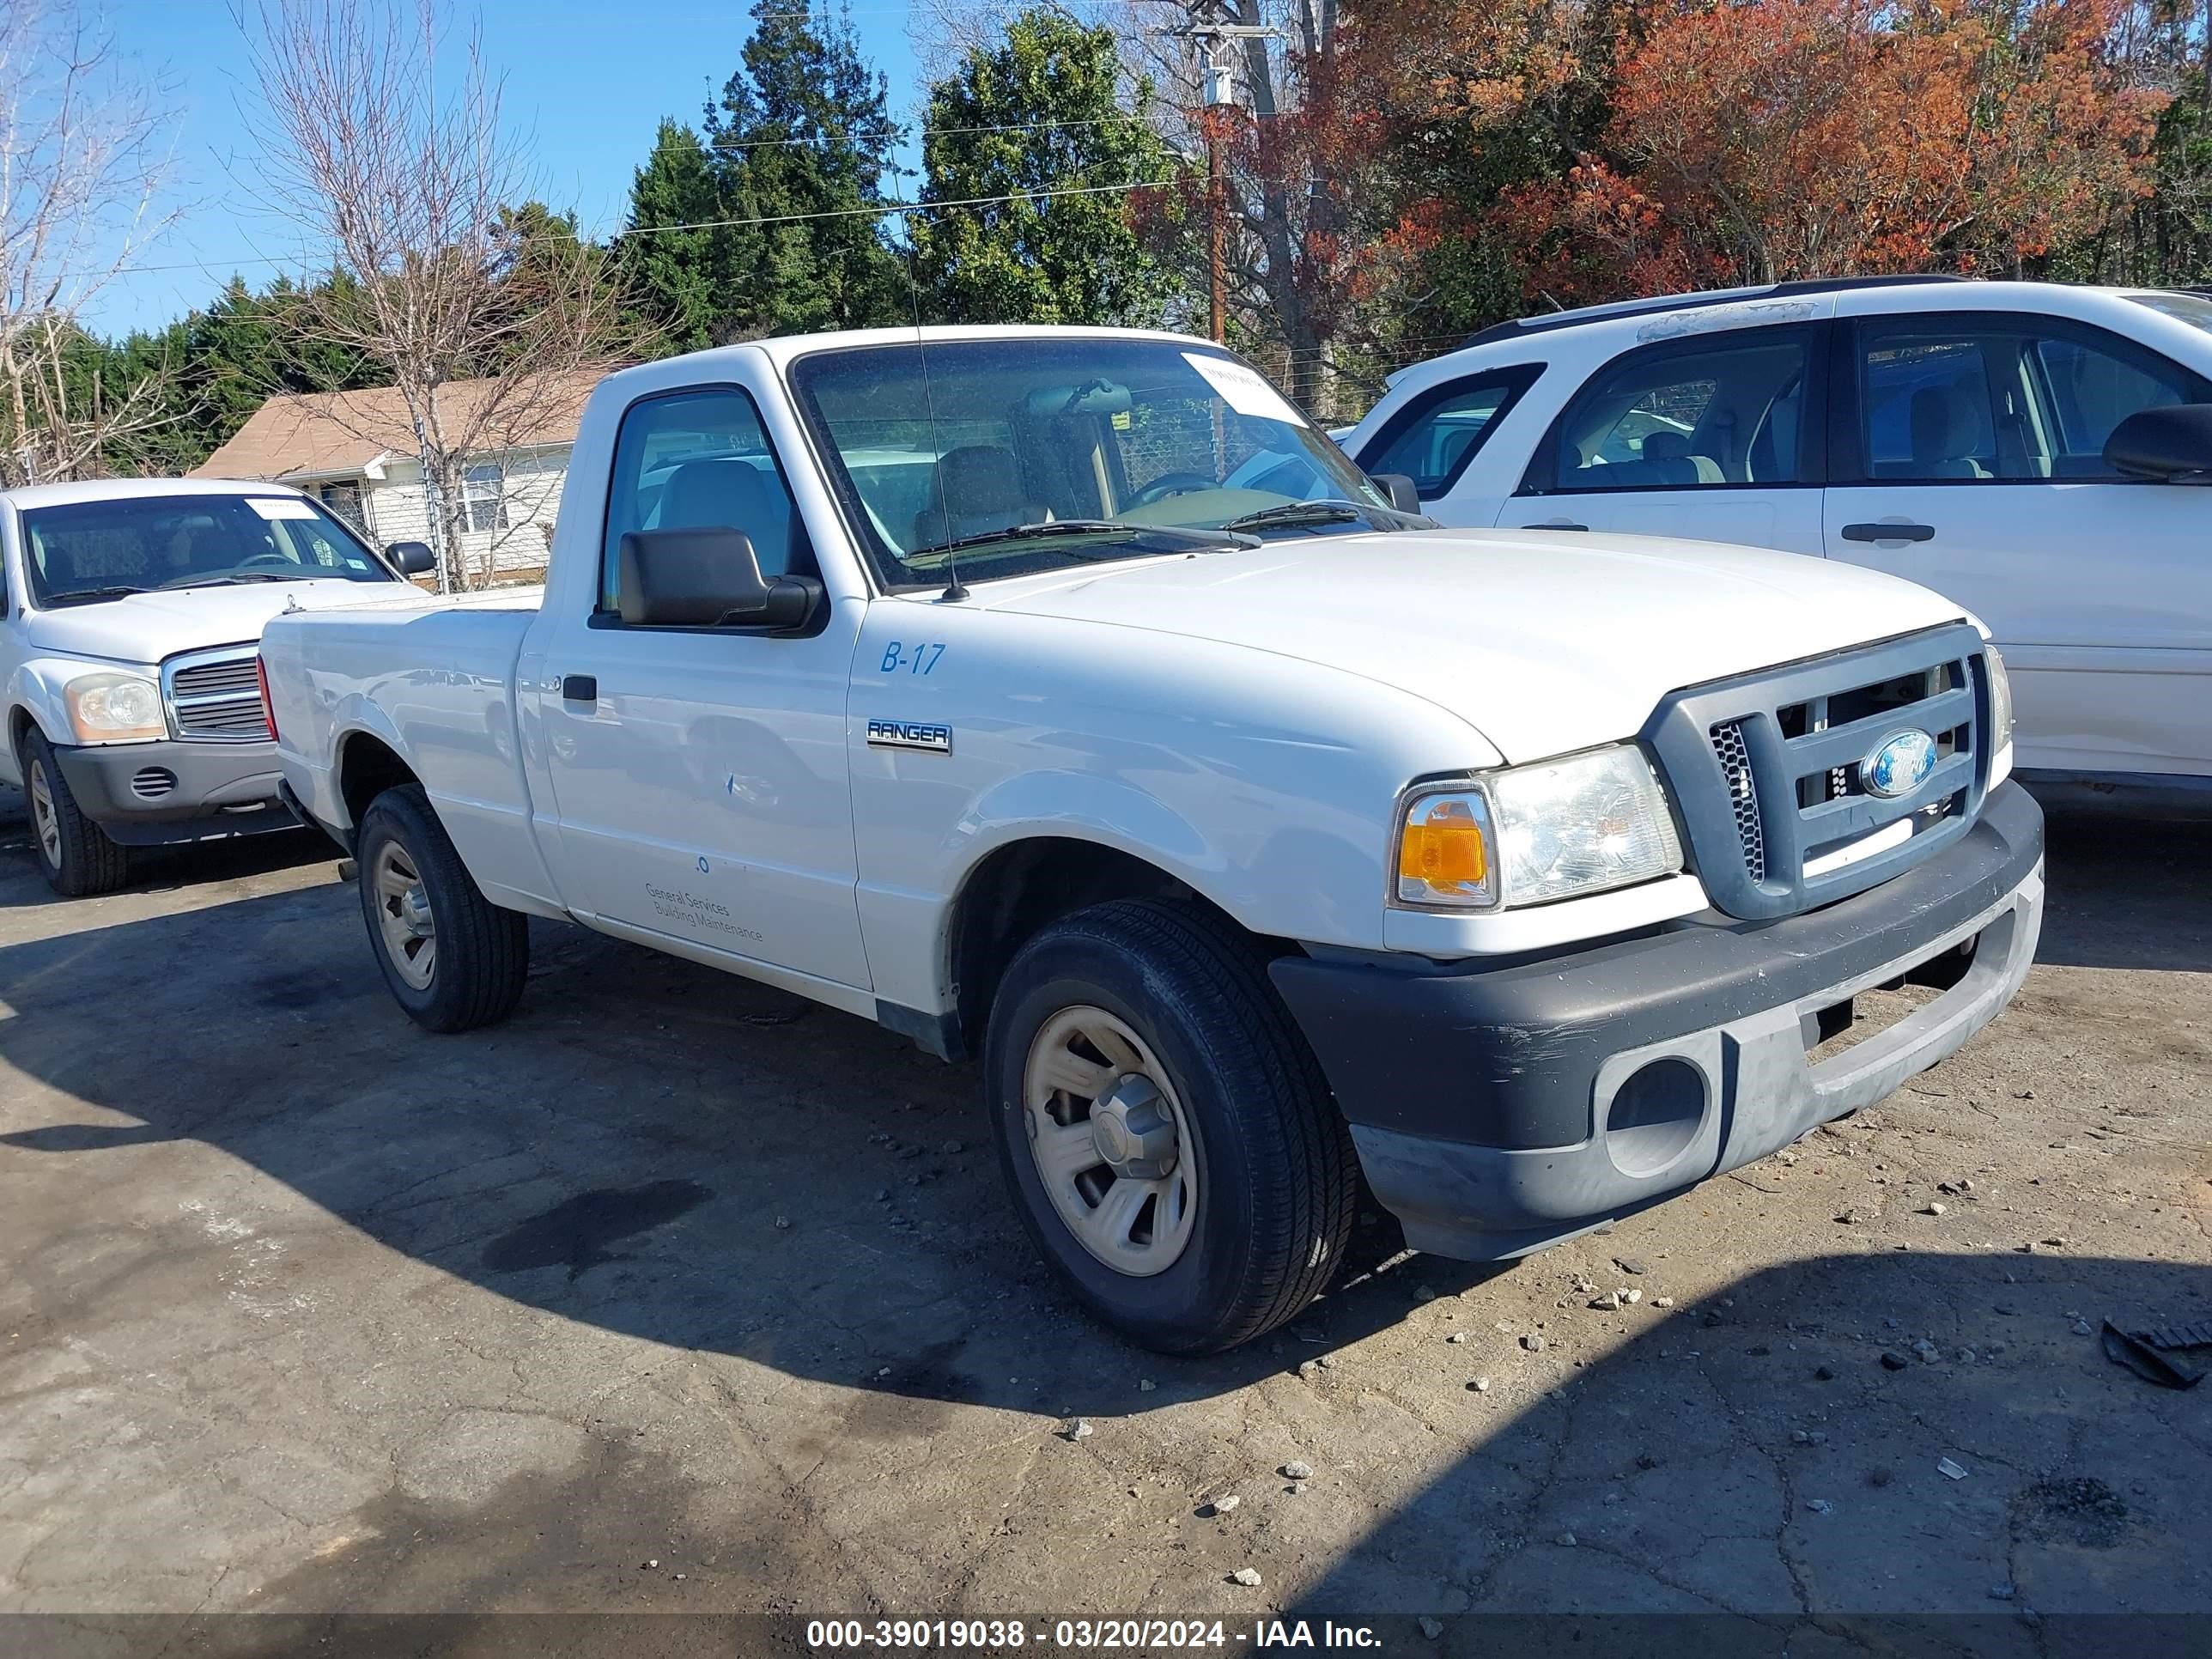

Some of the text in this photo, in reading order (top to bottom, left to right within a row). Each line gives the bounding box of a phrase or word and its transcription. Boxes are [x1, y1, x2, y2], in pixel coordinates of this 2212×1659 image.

[881, 641, 945, 675] B-17
[868, 722, 948, 743] RANGER
[646, 883, 730, 916] General Services
[653, 901, 763, 942] Building Maintenance
